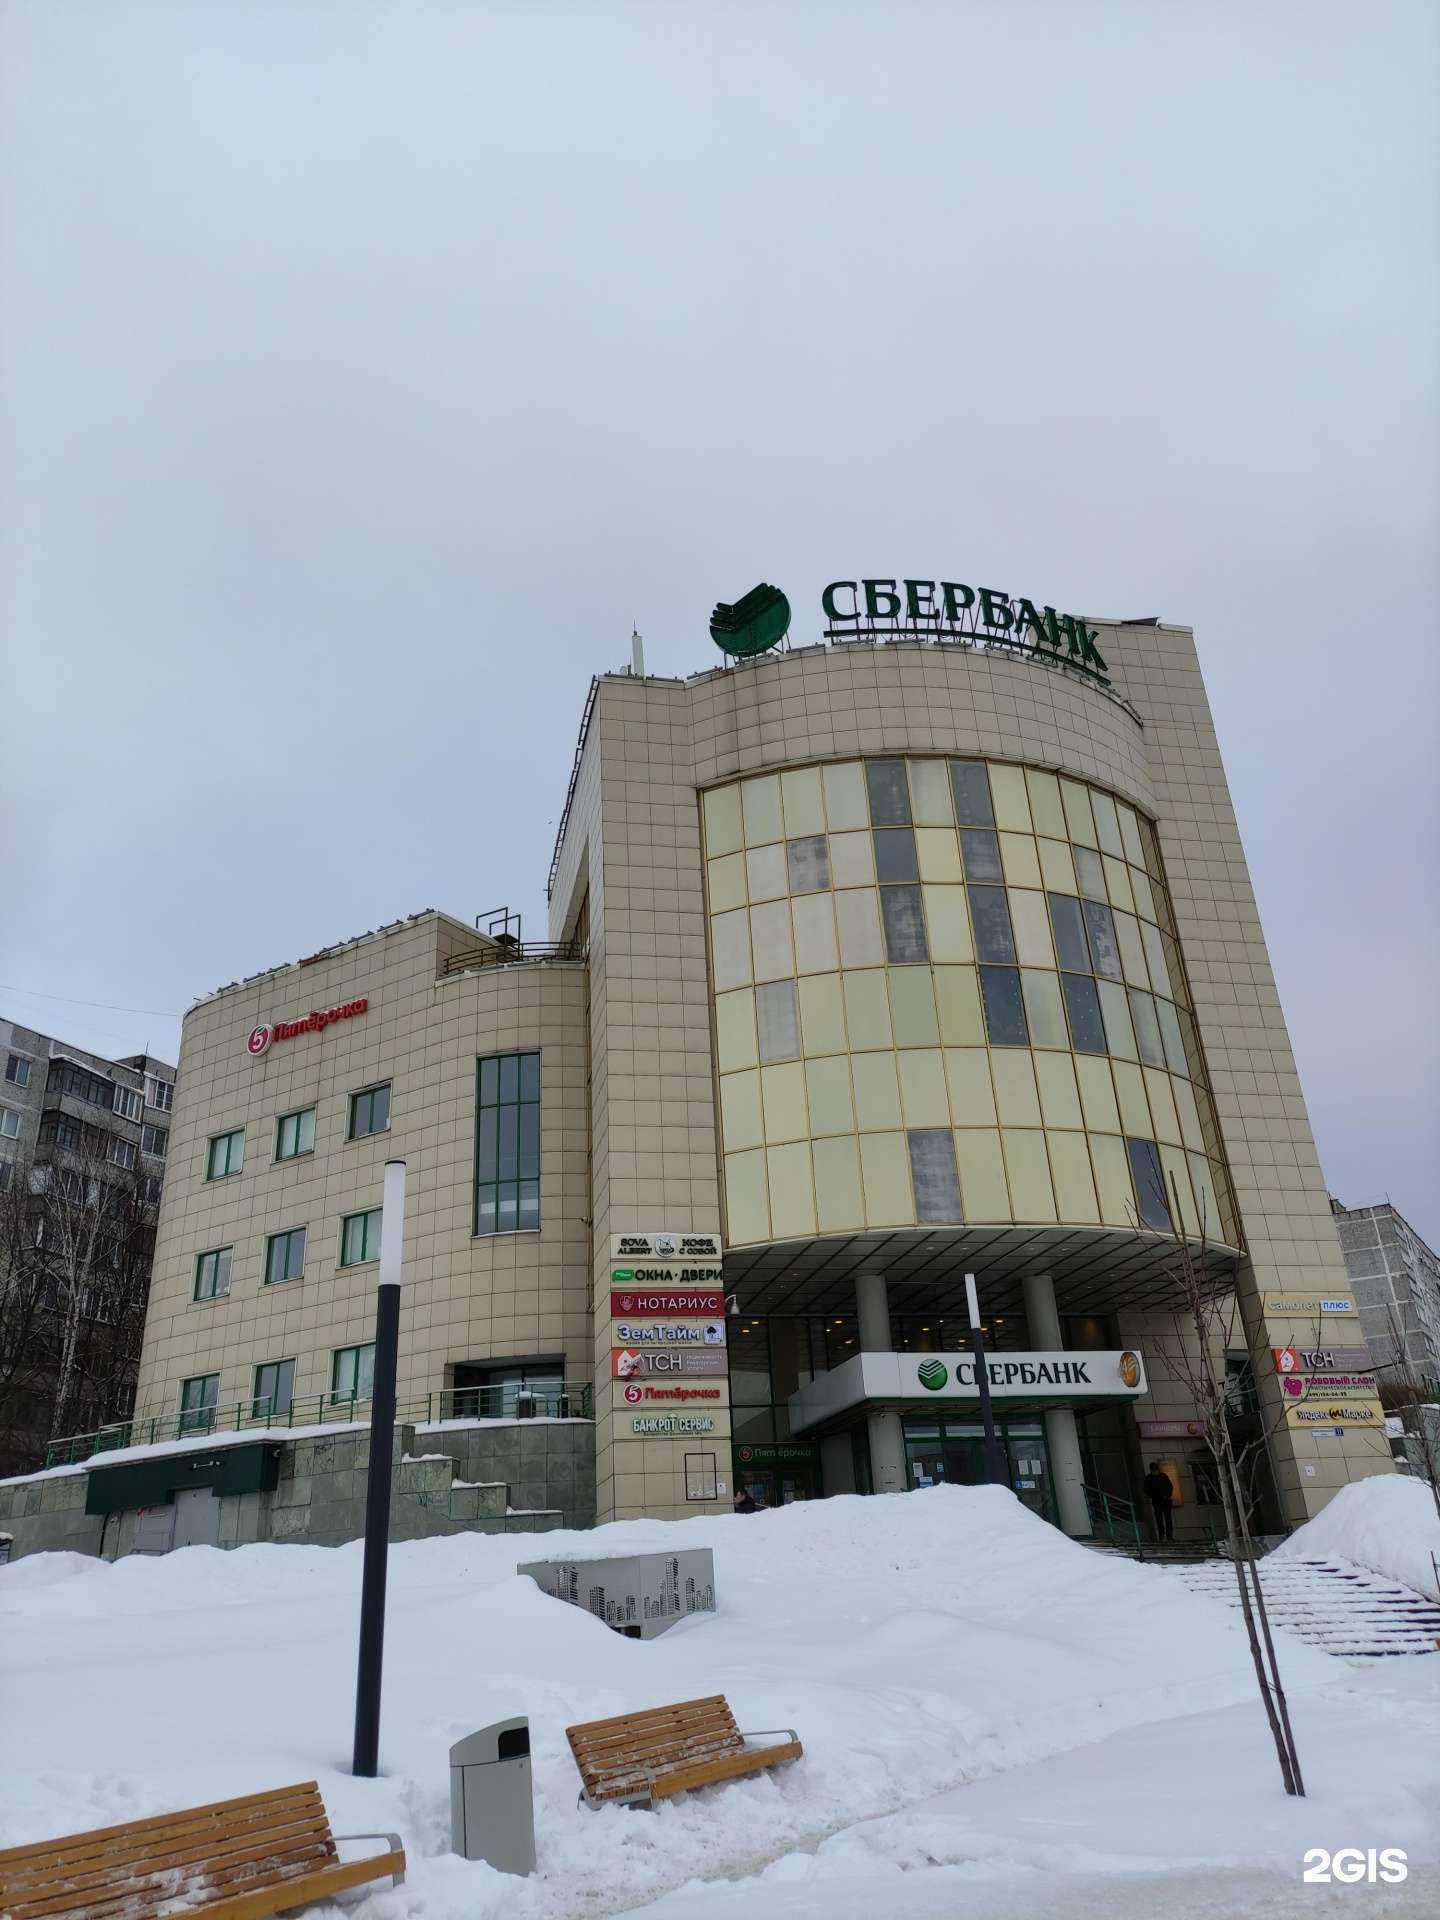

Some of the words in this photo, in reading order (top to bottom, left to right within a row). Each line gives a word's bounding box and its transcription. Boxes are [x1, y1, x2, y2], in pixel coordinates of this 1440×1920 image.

[822, 579, 1108, 671] СБЕРБАНК
[620, 1238, 648, 1247] SOVA
[682, 1239, 713, 1247] КОФЕ
[635, 1269, 673, 1281] ОКНА
[680, 1269, 722, 1282] ДВЕРИ
[638, 1297, 718, 1309] НОТАРИУС
[618, 1323, 700, 1340] ЗемТайм
[645, 1354, 682, 1371] ТСН
[1301, 1352, 1335, 1368] ТСН
[956, 1362, 1091, 1385] СЕРБАНК
[644, 1387, 720, 1402] Пятёрочка
[633, 1419, 676, 1432] БАНКРОТ
[679, 1418, 714, 1431] СЕРВИС
